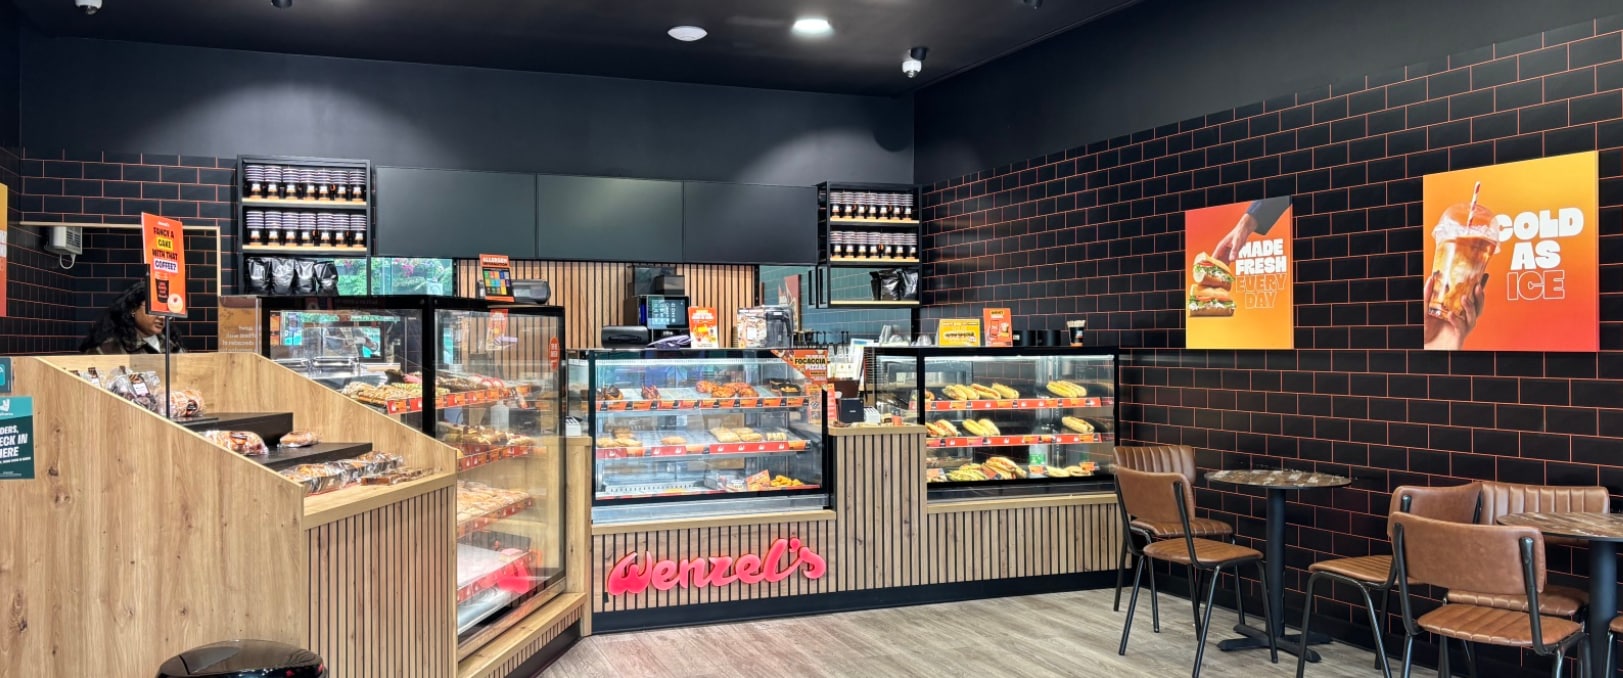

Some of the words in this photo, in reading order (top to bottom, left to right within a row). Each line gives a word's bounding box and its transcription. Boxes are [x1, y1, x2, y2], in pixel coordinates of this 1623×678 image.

[153, 227, 170, 237] FANCY
[1490, 207, 1584, 242] COLD
[158, 239, 171, 249] CAKE
[1238, 238, 1284, 259] MADE
[152, 249, 166, 259] WITH
[166, 251, 178, 261] THAT
[1235, 255, 1287, 275] FRESH
[1510, 240, 1561, 270] AS
[155, 260, 177, 271] COFFEE?
[1235, 273, 1287, 293] EVERY
[1507, 270, 1565, 301] ICE
[1245, 291, 1277, 309] DAY
[17, 433, 28, 445] IN
[607, 537, 826, 596] Wenzel's
